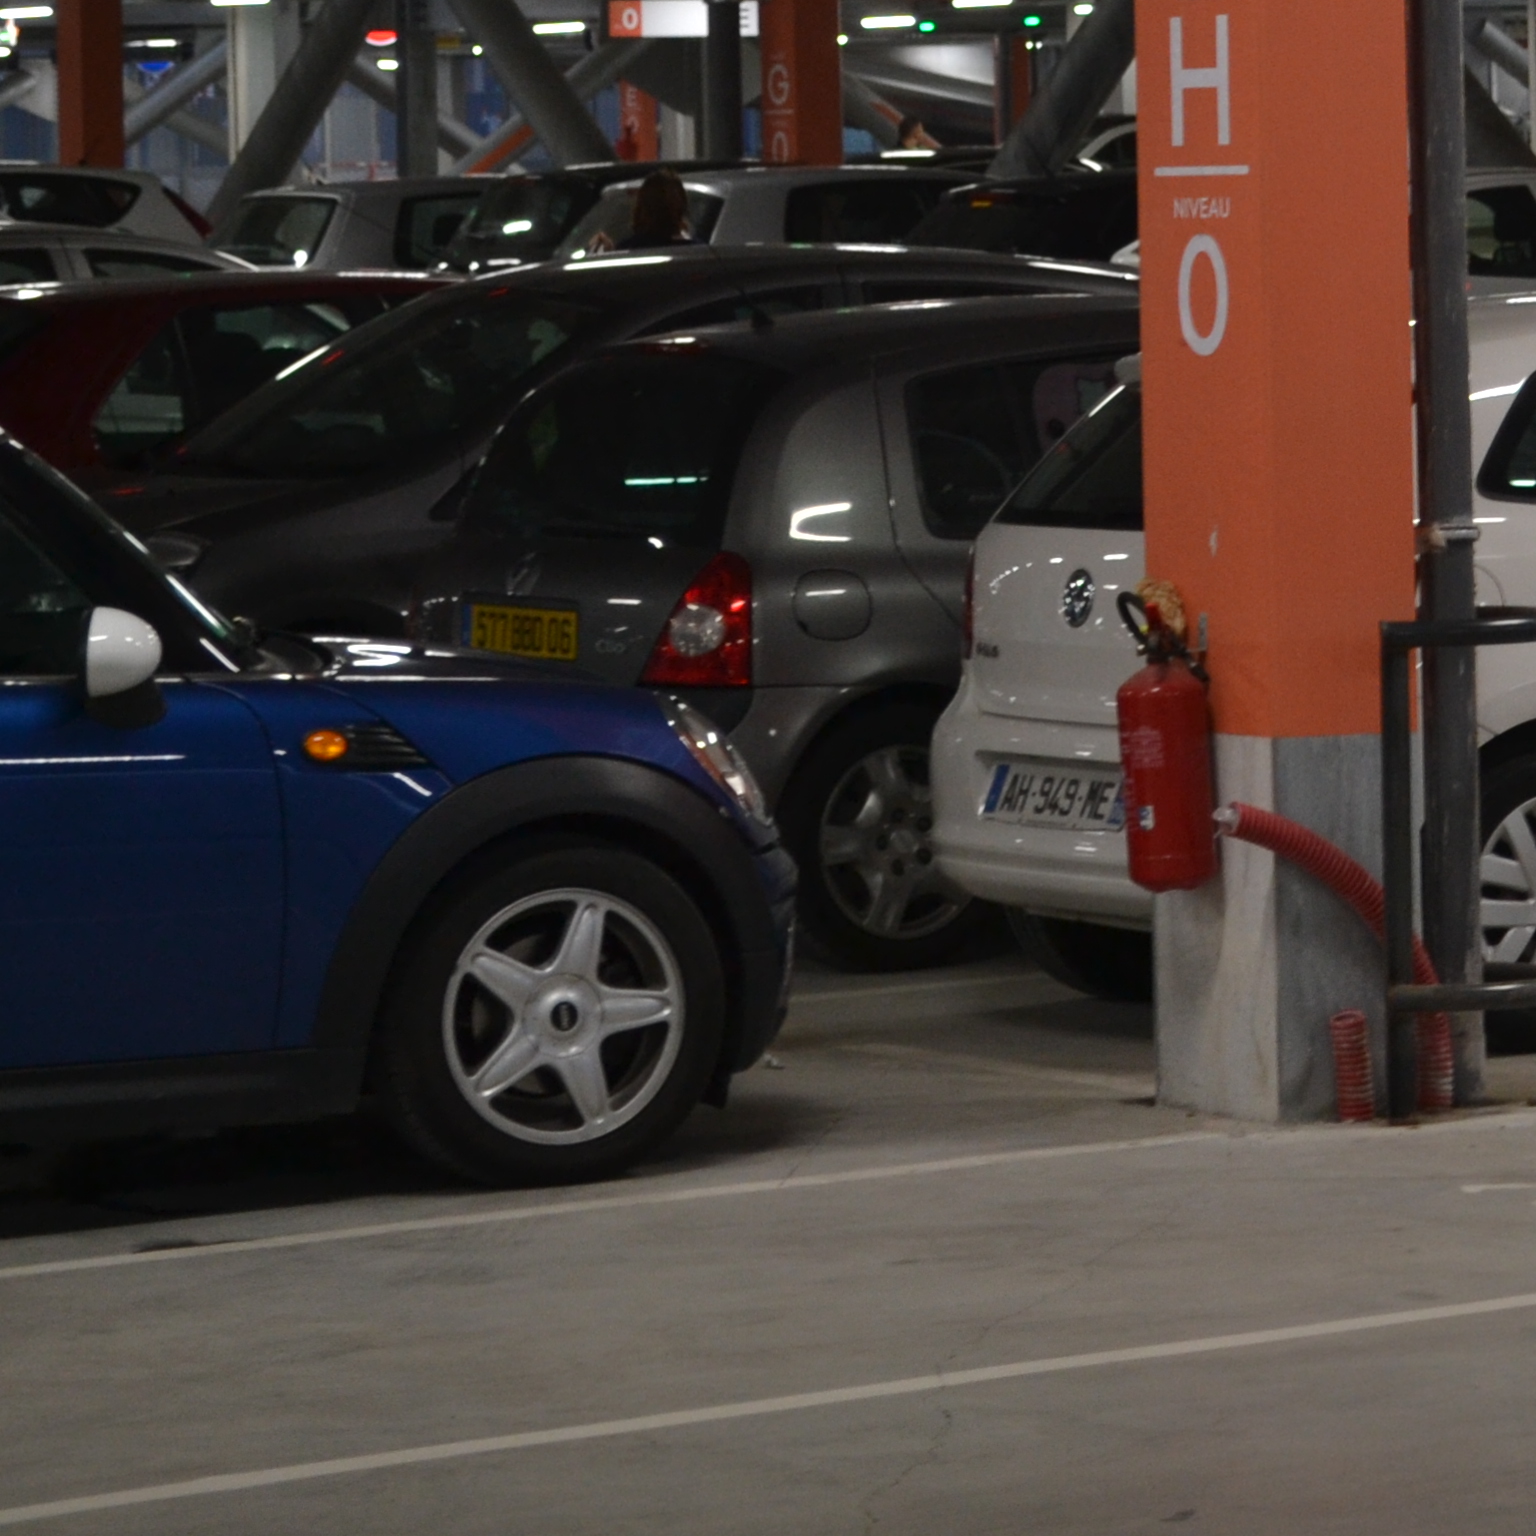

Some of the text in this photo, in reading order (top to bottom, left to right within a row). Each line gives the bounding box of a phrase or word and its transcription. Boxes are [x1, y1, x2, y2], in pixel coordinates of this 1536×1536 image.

[767, 63, 790, 105] G
[1169, 13, 1231, 147] H
[1173, 196, 1231, 220] NIVEAU
